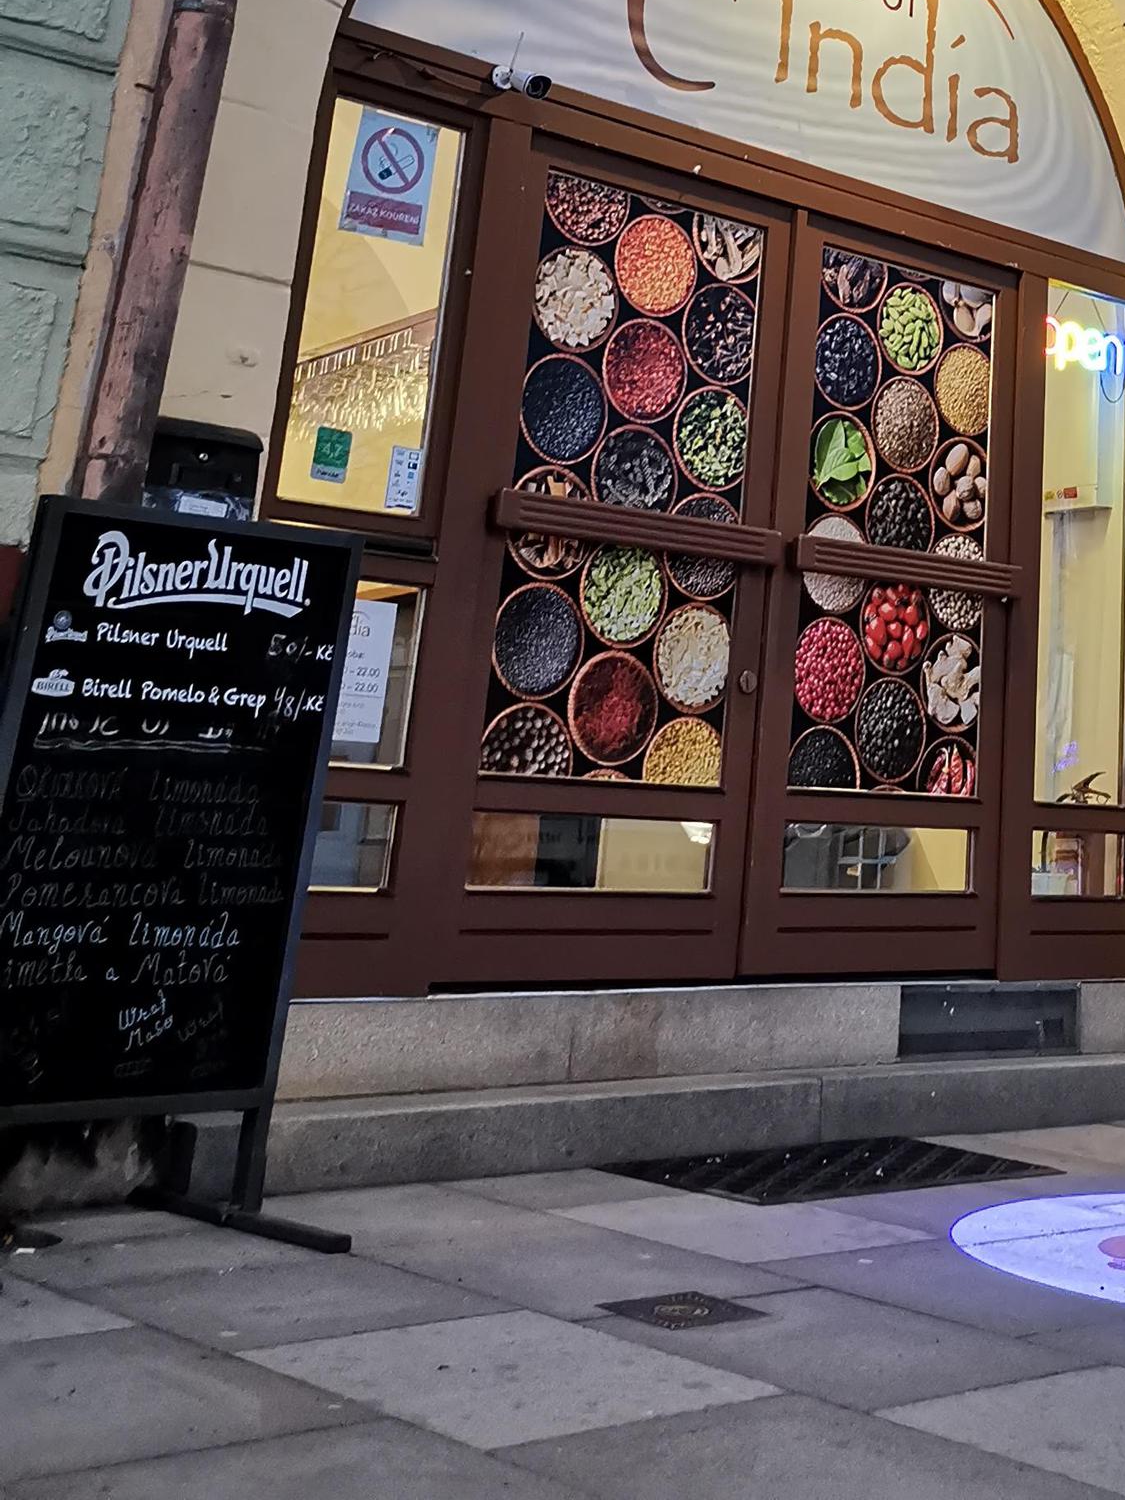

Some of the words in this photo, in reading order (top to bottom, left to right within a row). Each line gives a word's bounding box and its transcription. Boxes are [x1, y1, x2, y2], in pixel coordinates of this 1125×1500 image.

[96, 623, 160, 646] Pilsner
[166, 629, 228, 659] Urquell
[35, 680, 70, 693] BIRELL
[81, 678, 132, 699] Birell
[141, 681, 206, 705] Pomelo
[207, 686, 221, 705] &
[223, 688, 266, 718] Grep
